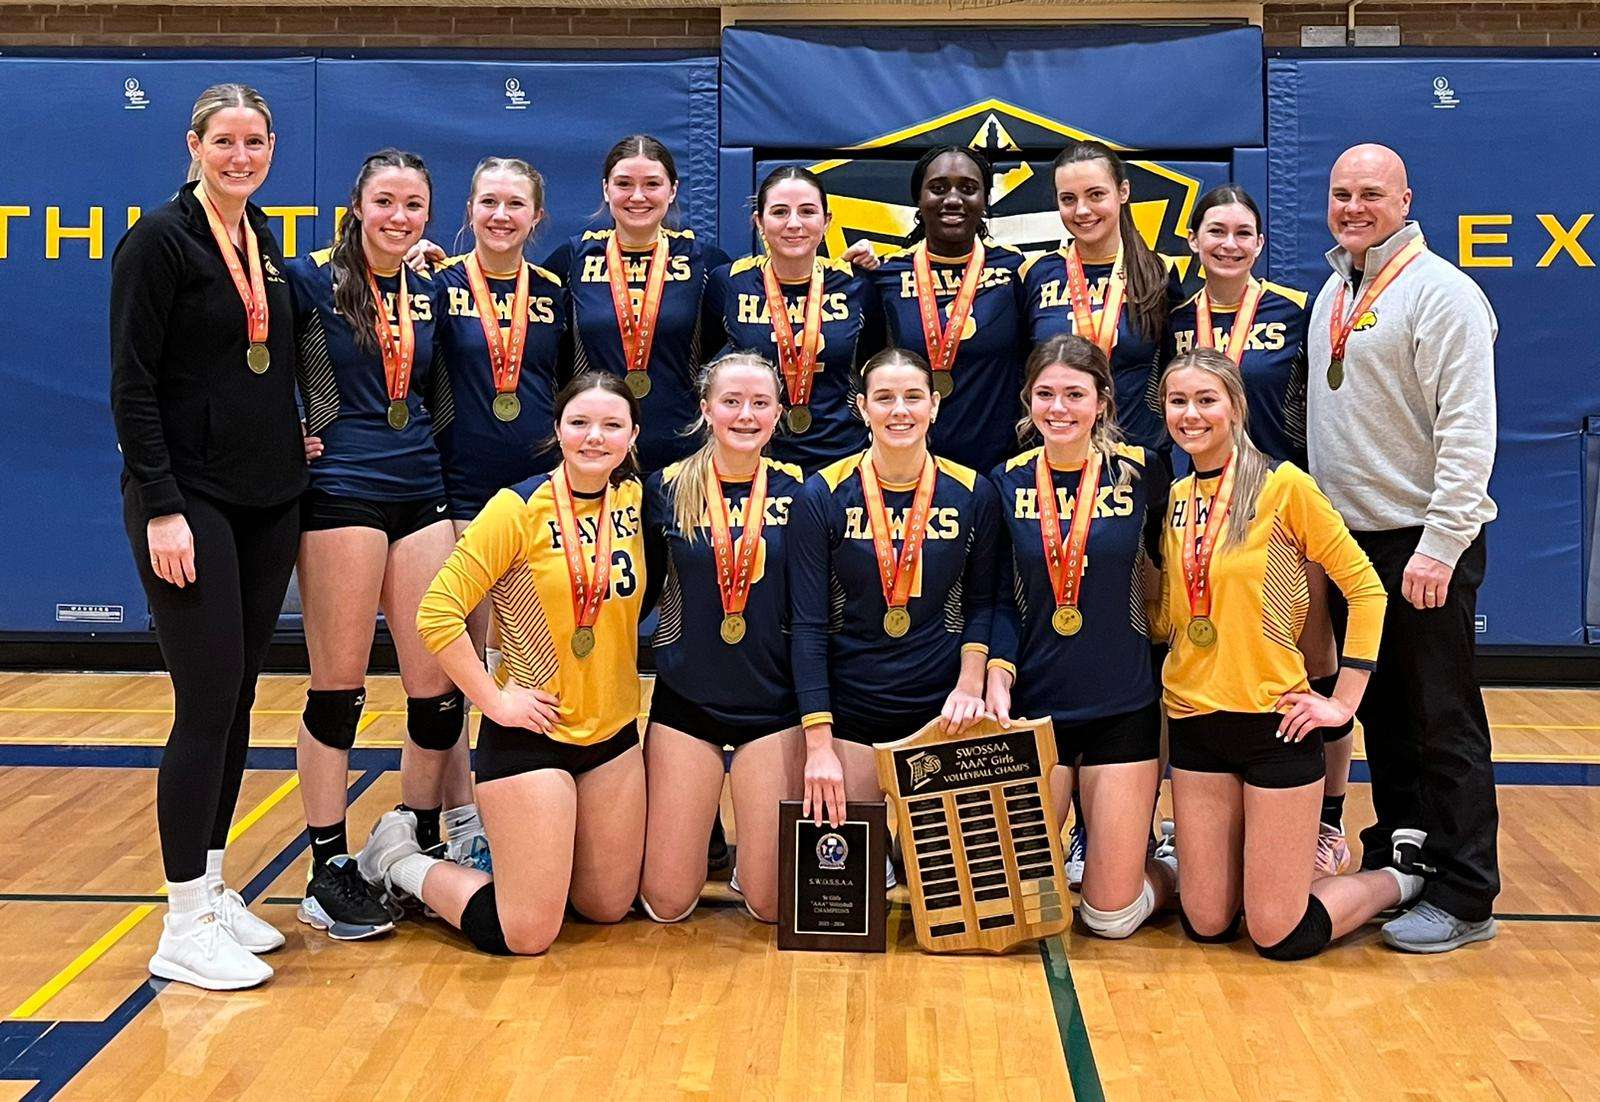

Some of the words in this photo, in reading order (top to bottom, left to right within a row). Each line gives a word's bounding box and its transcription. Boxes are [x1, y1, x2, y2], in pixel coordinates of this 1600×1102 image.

[1459, 214, 1596, 268] EX
[581, 255, 692, 283] HWS
[447, 286, 556, 324] HWKS
[1174, 322, 1288, 356] HWKS
[1015, 485, 1133, 520] HWKS
[844, 506, 960, 540] HWKS
[590, 549, 638, 601] 3
[955, 741, 1010, 759] SWOSSAA
[990, 753, 1014, 765] Girls
[943, 768, 993, 783] VOLLEYBALL
[994, 762, 1030, 775] CHAMPS
